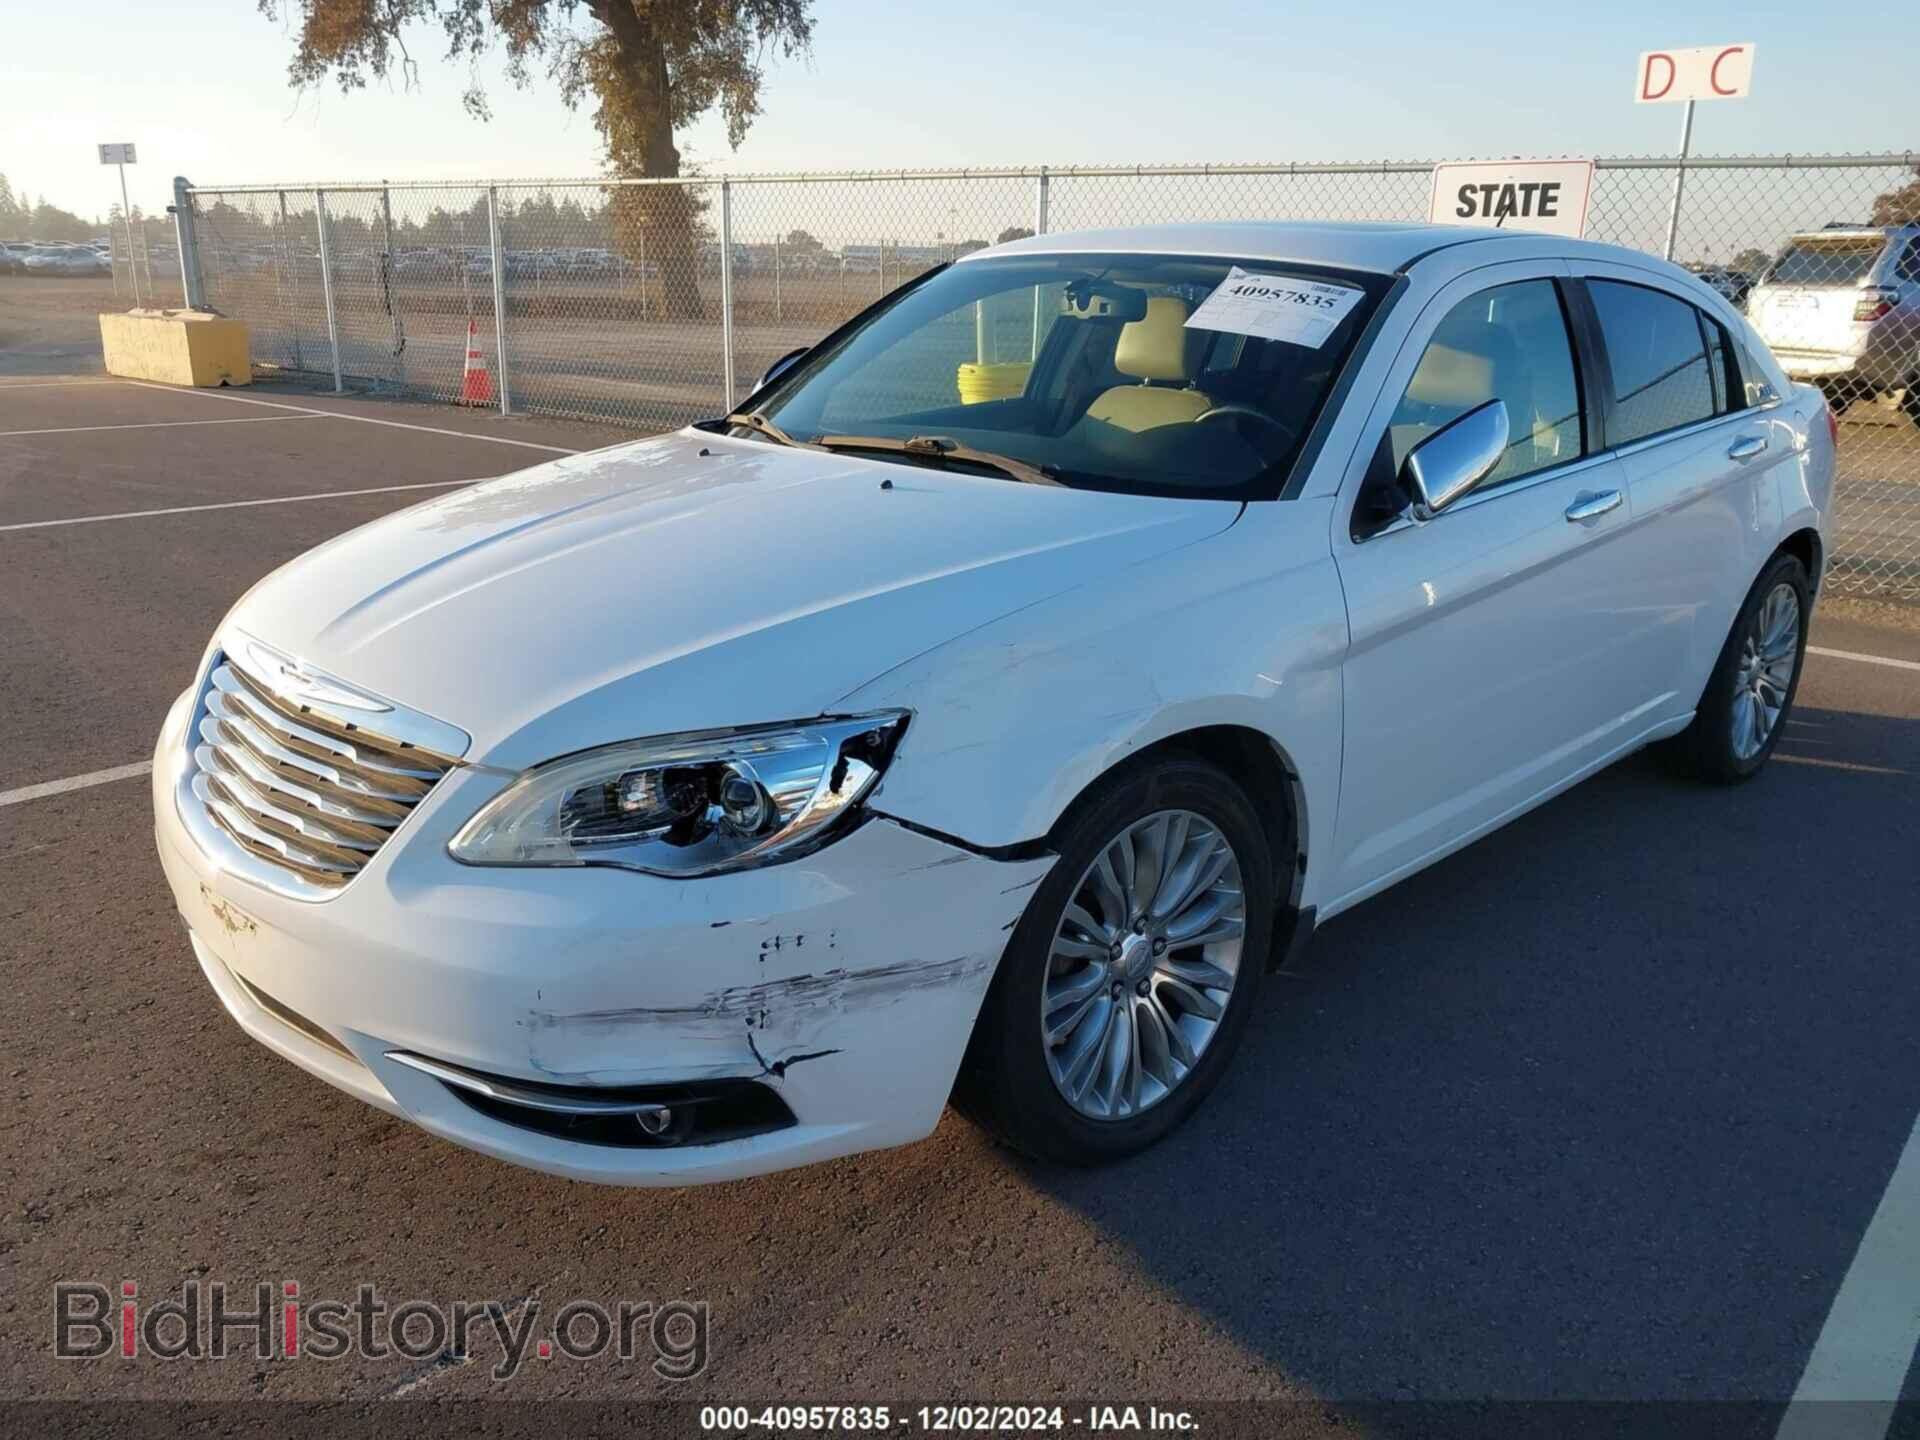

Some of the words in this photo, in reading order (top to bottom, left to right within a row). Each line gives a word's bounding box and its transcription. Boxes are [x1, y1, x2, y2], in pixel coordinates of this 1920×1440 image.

[1642, 53, 1676, 100] D
[1710, 47, 1745, 96] C
[1456, 182, 1562, 218] STATE
[1229, 284, 1339, 309] 40957835
